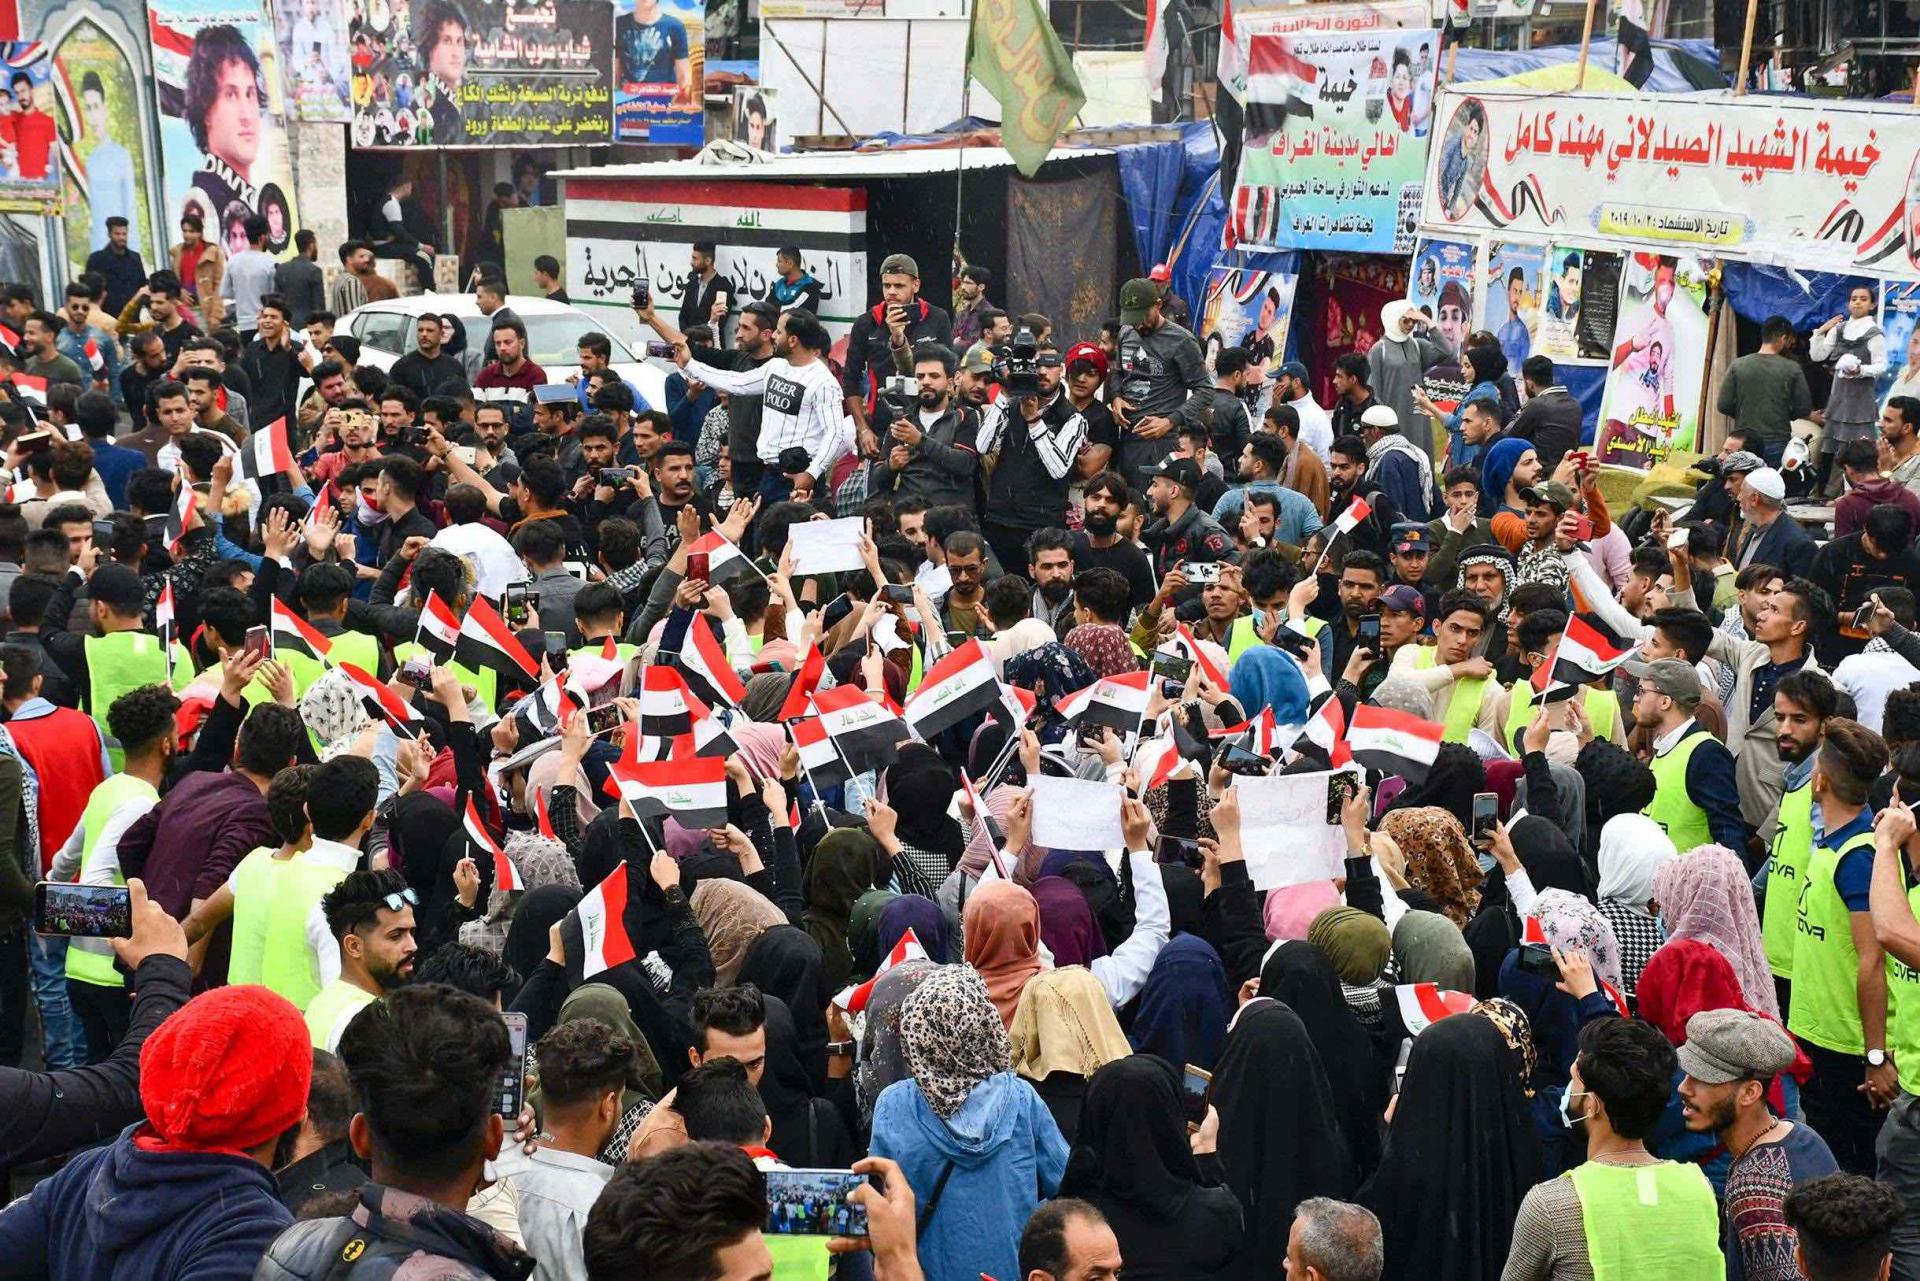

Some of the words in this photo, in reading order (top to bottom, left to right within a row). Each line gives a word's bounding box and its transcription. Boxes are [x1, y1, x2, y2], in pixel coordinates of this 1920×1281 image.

[472, 33, 523, 64] الشامية
[525, 43, 557, 65] صوب
[558, 34, 591, 65] شباب
[518, 84, 557, 106] الصبخة
[558, 85, 583, 107] تربة
[584, 85, 609, 107] ندفع
[1319, 64, 1358, 113] خيمة
[465, 118, 488, 135] ورود
[491, 115, 526, 132] الطغاة
[527, 115, 551, 132] عناد
[553, 116, 572, 135] على
[1272, 130, 1320, 164] الغراف
[1324, 126, 1360, 168] مدينة
[1504, 110, 1557, 163] كامل
[1559, 113, 1604, 168] مهند
[1607, 114, 1722, 181] الصيدلاني
[1362, 130, 1399, 171] اهالي
[1725, 116, 1809, 184] الشهيد
[1815, 119, 1881, 192] خيمة
[1313, 177, 1335, 196] ساحة
[736, 209, 762, 228] الله
[1293, 213, 1318, 235] الغراف
[1318, 215, 1354, 236] تظاهرات
[1356, 215, 1374, 237] لجنة
[1705, 219, 1729, 239] تاريخ
[584, 242, 649, 297] الحرية
[769, 378, 797, 398] TIGER
[766, 392, 791, 410] POLO
[1205, 533, 1224, 552] 13
